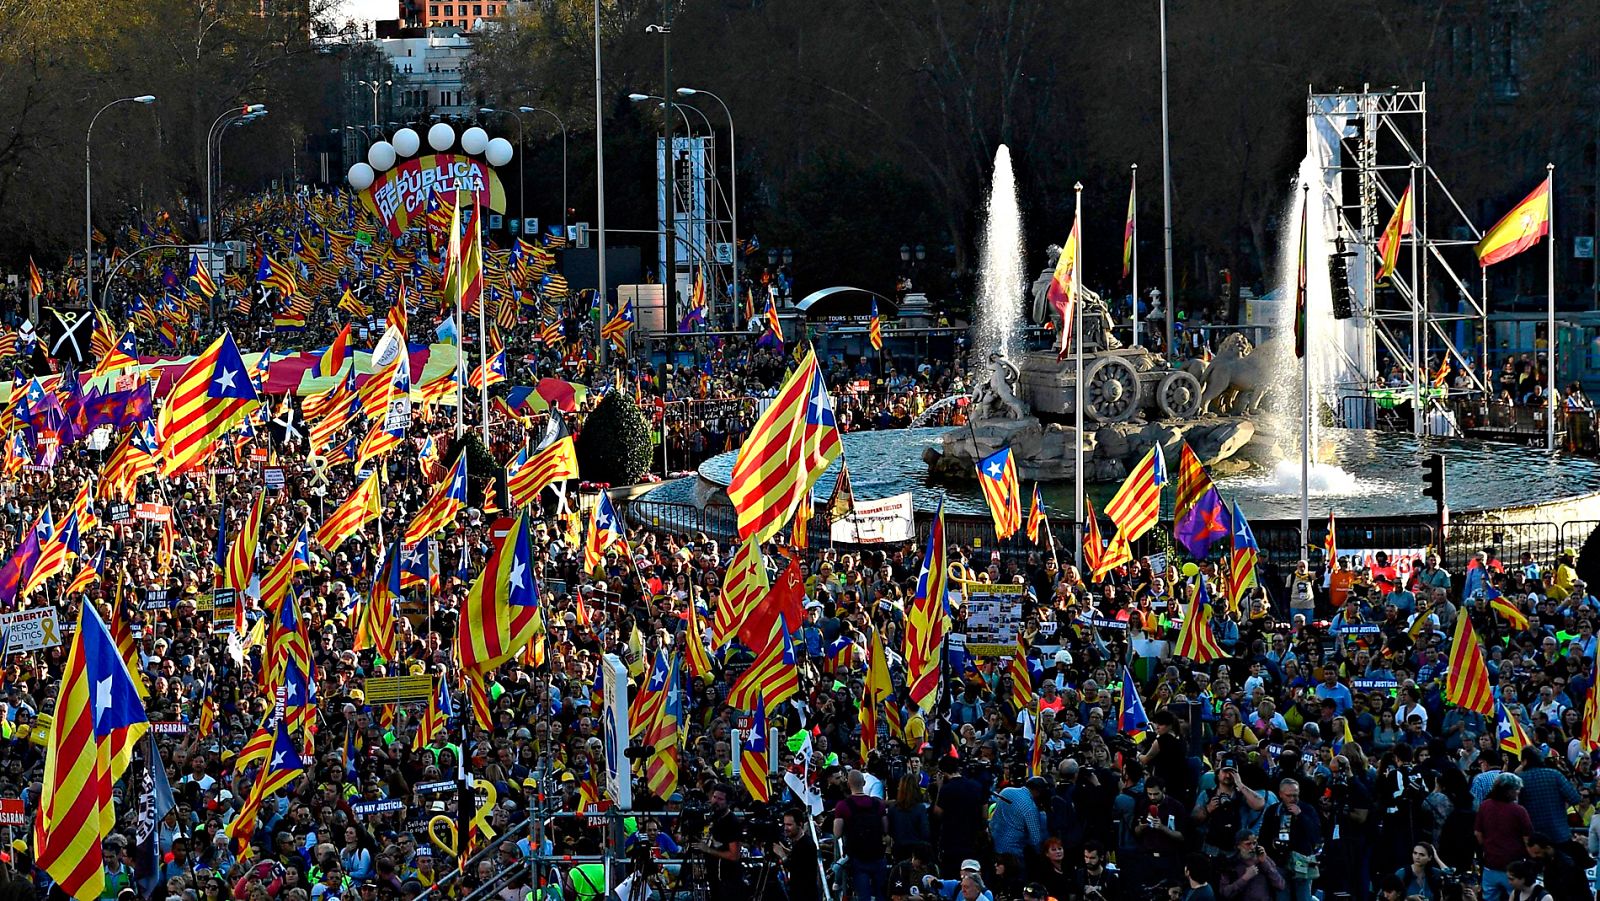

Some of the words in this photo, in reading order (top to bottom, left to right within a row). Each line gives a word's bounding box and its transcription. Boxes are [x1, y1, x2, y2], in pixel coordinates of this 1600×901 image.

[374, 180, 394, 206] FEM
[396, 169, 411, 184] LA
[379, 162, 483, 226] REPÚBLICA
[406, 176, 485, 212] CATALANA
[148, 591, 156, 600] NO
[156, 590, 167, 600] HAY
[11, 621, 38, 632] RESOS
[10, 630, 43, 642] OLÍTICS
[276, 686, 286, 696] NO
[154, 722, 187, 733] PASARÁN
[738, 718, 748, 727] NO
[355, 804, 363, 814] NO
[364, 802, 375, 813] HAY
[588, 803, 598, 813] NO
[0, 811, 24, 824] ASARÁN
[588, 815, 610, 826] PASA
